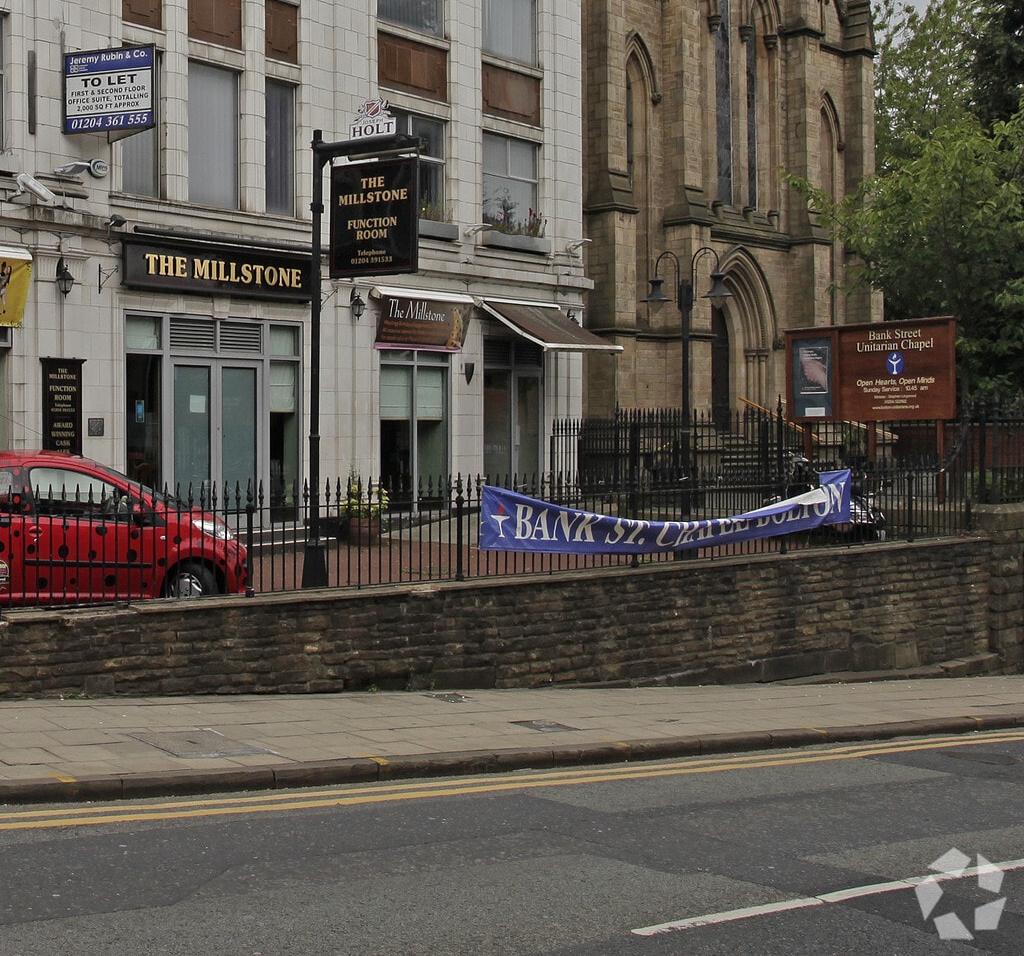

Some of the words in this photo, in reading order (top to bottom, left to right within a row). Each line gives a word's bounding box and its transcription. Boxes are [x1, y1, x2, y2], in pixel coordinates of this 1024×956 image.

[70, 54, 98, 65] Jeremy
[101, 51, 123, 62] Rubin
[125, 50, 131, 59] &
[133, 49, 148, 58] Co.
[81, 77, 101, 88] TO
[107, 73, 137, 86] LET
[97, 87, 123, 95] SECOND
[114, 92, 149, 101] TOTALLING
[71, 117, 102, 129] 01204
[105, 115, 124, 127] 361
[127, 113, 148, 125] 555
[352, 121, 394, 138] HOLT
[360, 176, 385, 189] THE
[338, 188, 408, 206] MILLSTONE
[347, 216, 397, 230] FUNCTION
[356, 228, 388, 240] ROOM
[357, 248, 387, 257] Telephone
[350, 256, 369, 265] 01204
[145, 253, 188, 278] THE
[193, 257, 302, 288] MILLSTONE
[388, 298, 405, 319] The
[405, 300, 446, 322] Millstone
[868, 329, 892, 341] Bank
[894, 328, 921, 339] Street
[856, 340, 898, 352] Unitarian
[900, 337, 934, 351] Chapel
[856, 379, 873, 387] Open
[898, 377, 916, 386] Open
[916, 376, 936, 384] Minds
[56, 439, 71, 447] CASK
[514, 503, 605, 542] BANK
[605, 517, 650, 545] ST.
